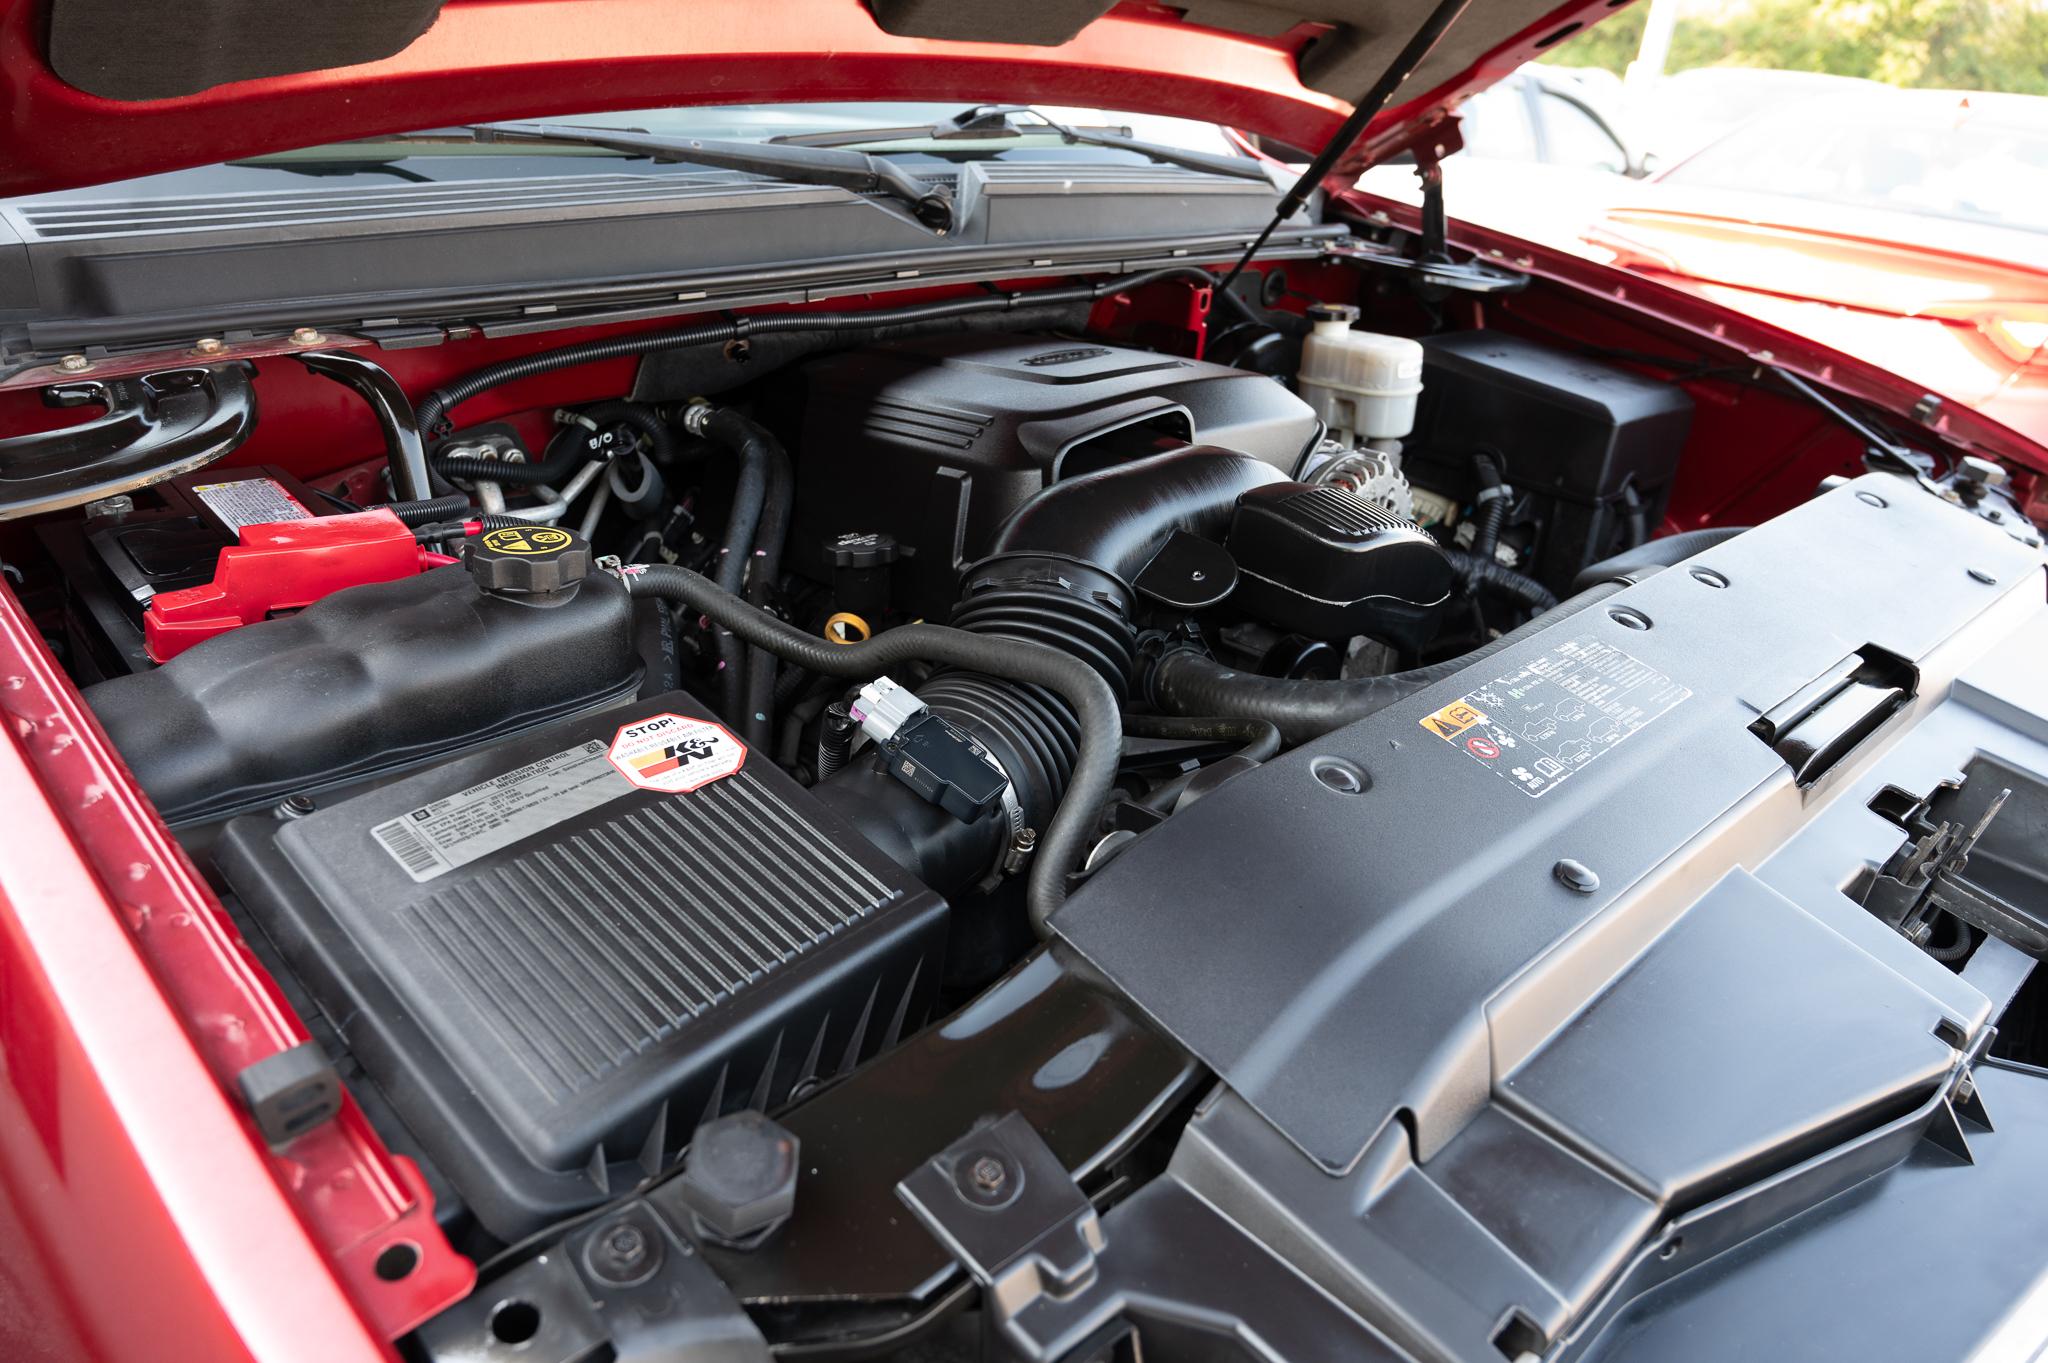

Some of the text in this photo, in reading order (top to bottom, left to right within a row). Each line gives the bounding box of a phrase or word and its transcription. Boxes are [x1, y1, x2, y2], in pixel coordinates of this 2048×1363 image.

[621, 723, 694, 750] DO NOT DISCARD
[625, 717, 676, 738] STOP!
[664, 736, 719, 767] K&N
[462, 781, 495, 798] VEHICLE
[496, 765, 535, 787] EMISSION
[535, 751, 571, 770] CONTROL
[495, 765, 550, 790] INFORMATION
[1526, 776, 1545, 790] AUTO
